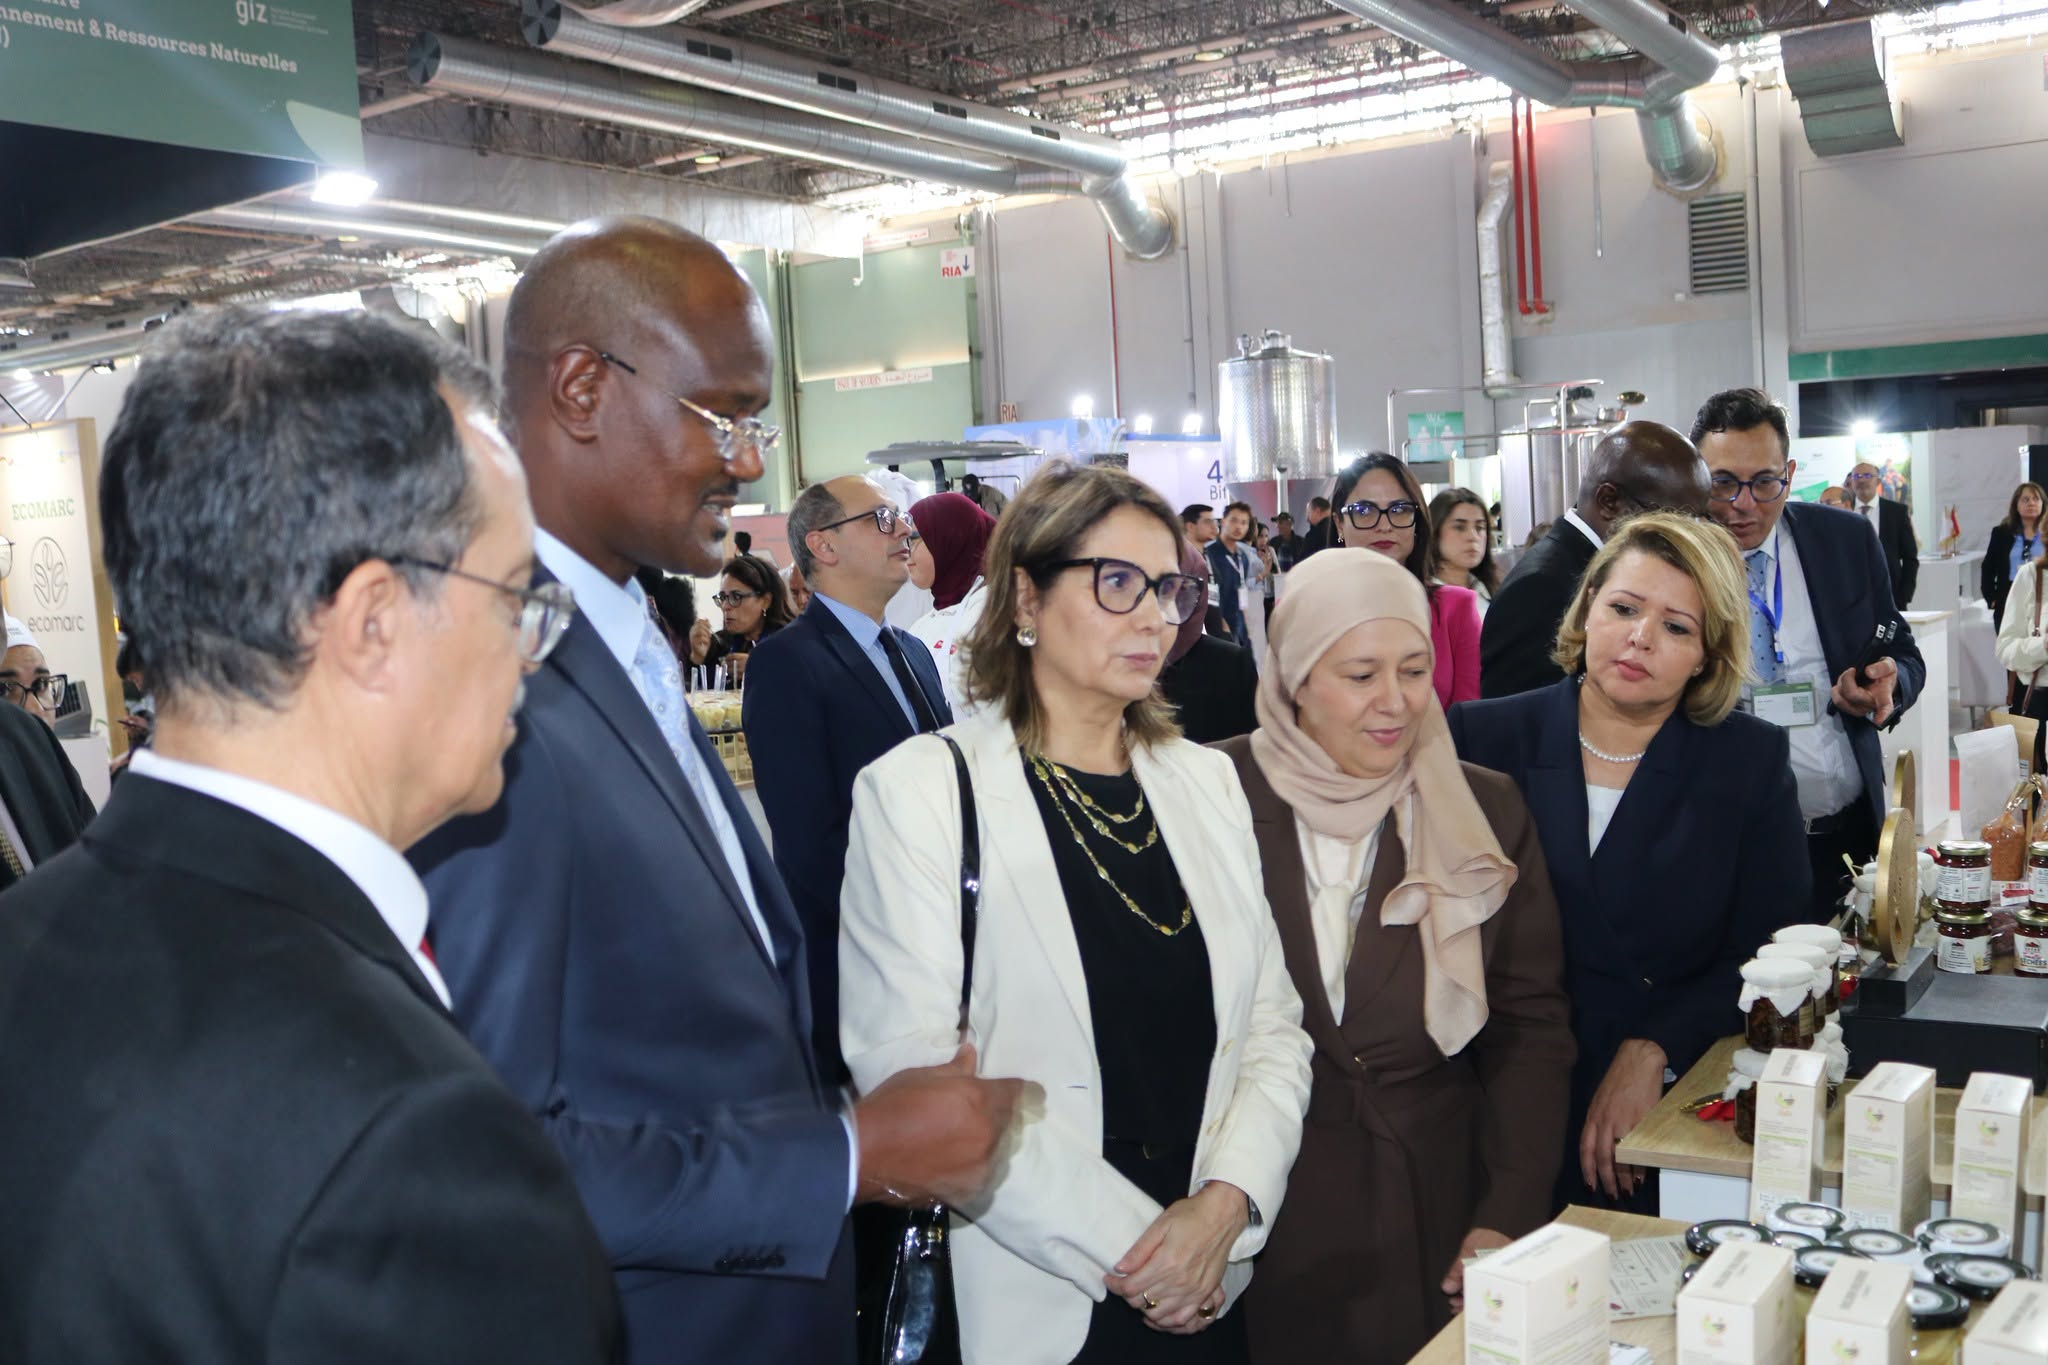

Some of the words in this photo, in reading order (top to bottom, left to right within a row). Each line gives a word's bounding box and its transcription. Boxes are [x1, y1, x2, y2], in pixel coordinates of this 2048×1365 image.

[236, 0, 268, 26] giz
[89, 18, 102, 38] &
[104, 22, 207, 57] Ressources
[210, 42, 298, 73] Naturelles
[942, 266, 962, 278] RIA
[1001, 404, 1018, 421] RIA
[1207, 460, 1223, 483] 4
[12, 498, 75, 520] ECOMARC
[28, 615, 85, 632] ecomarc
